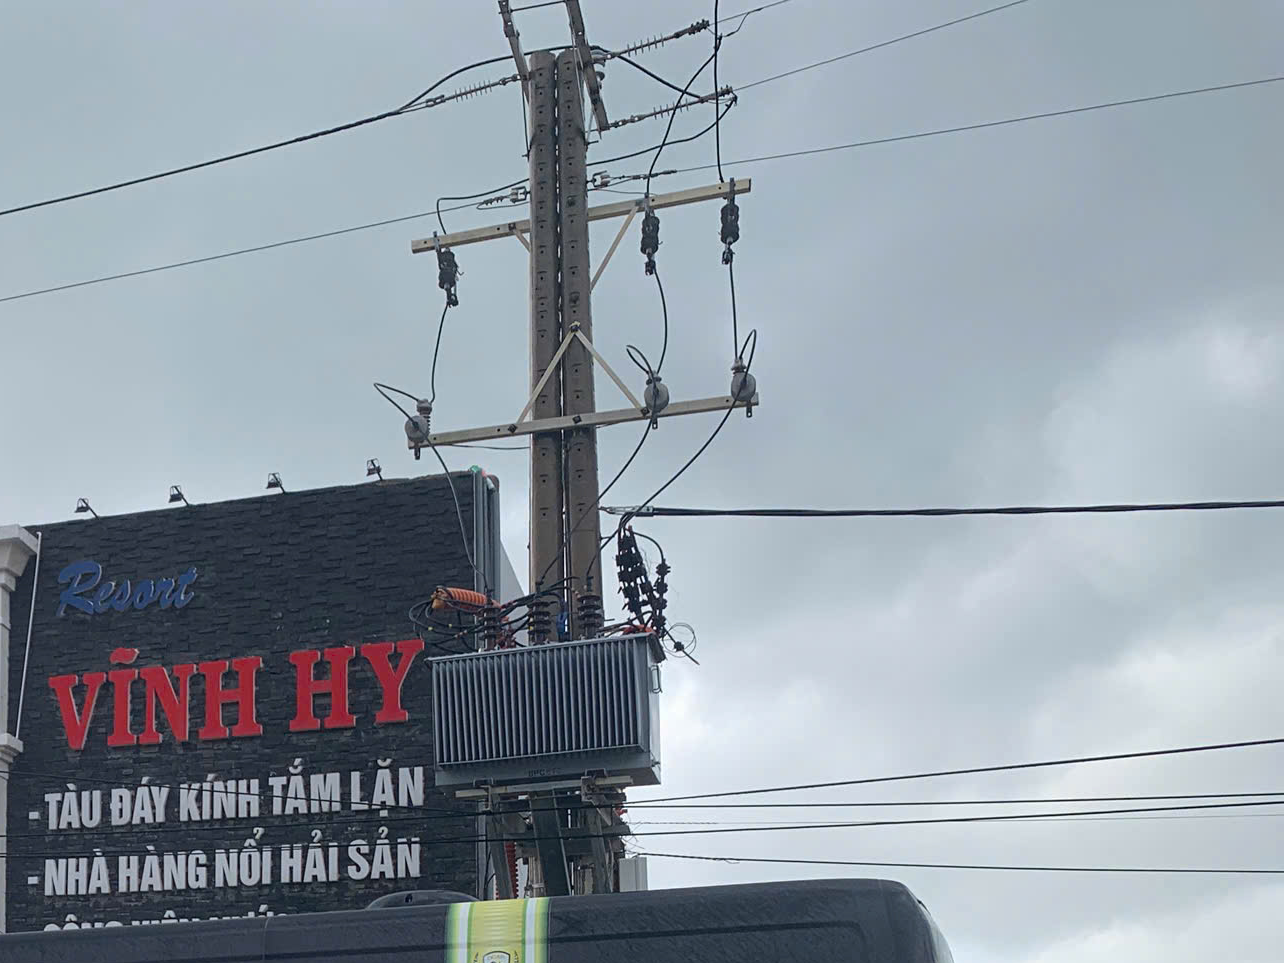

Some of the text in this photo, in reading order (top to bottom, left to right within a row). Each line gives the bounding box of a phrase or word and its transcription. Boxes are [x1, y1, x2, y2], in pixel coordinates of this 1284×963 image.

[55, 560, 198, 616] Resort
[48, 639, 425, 750] VĨNH HY
[110, 776, 170, 826] ĐÁY
[179, 773, 260, 822] KÍNH
[268, 758, 342, 816] TẮM
[350, 758, 425, 818] LẶN
[118, 845, 208, 893] HÀNG
[215, 827, 272, 888] NỔI
[280, 829, 340, 884] HẢI
[347, 826, 421, 881] SẢN
